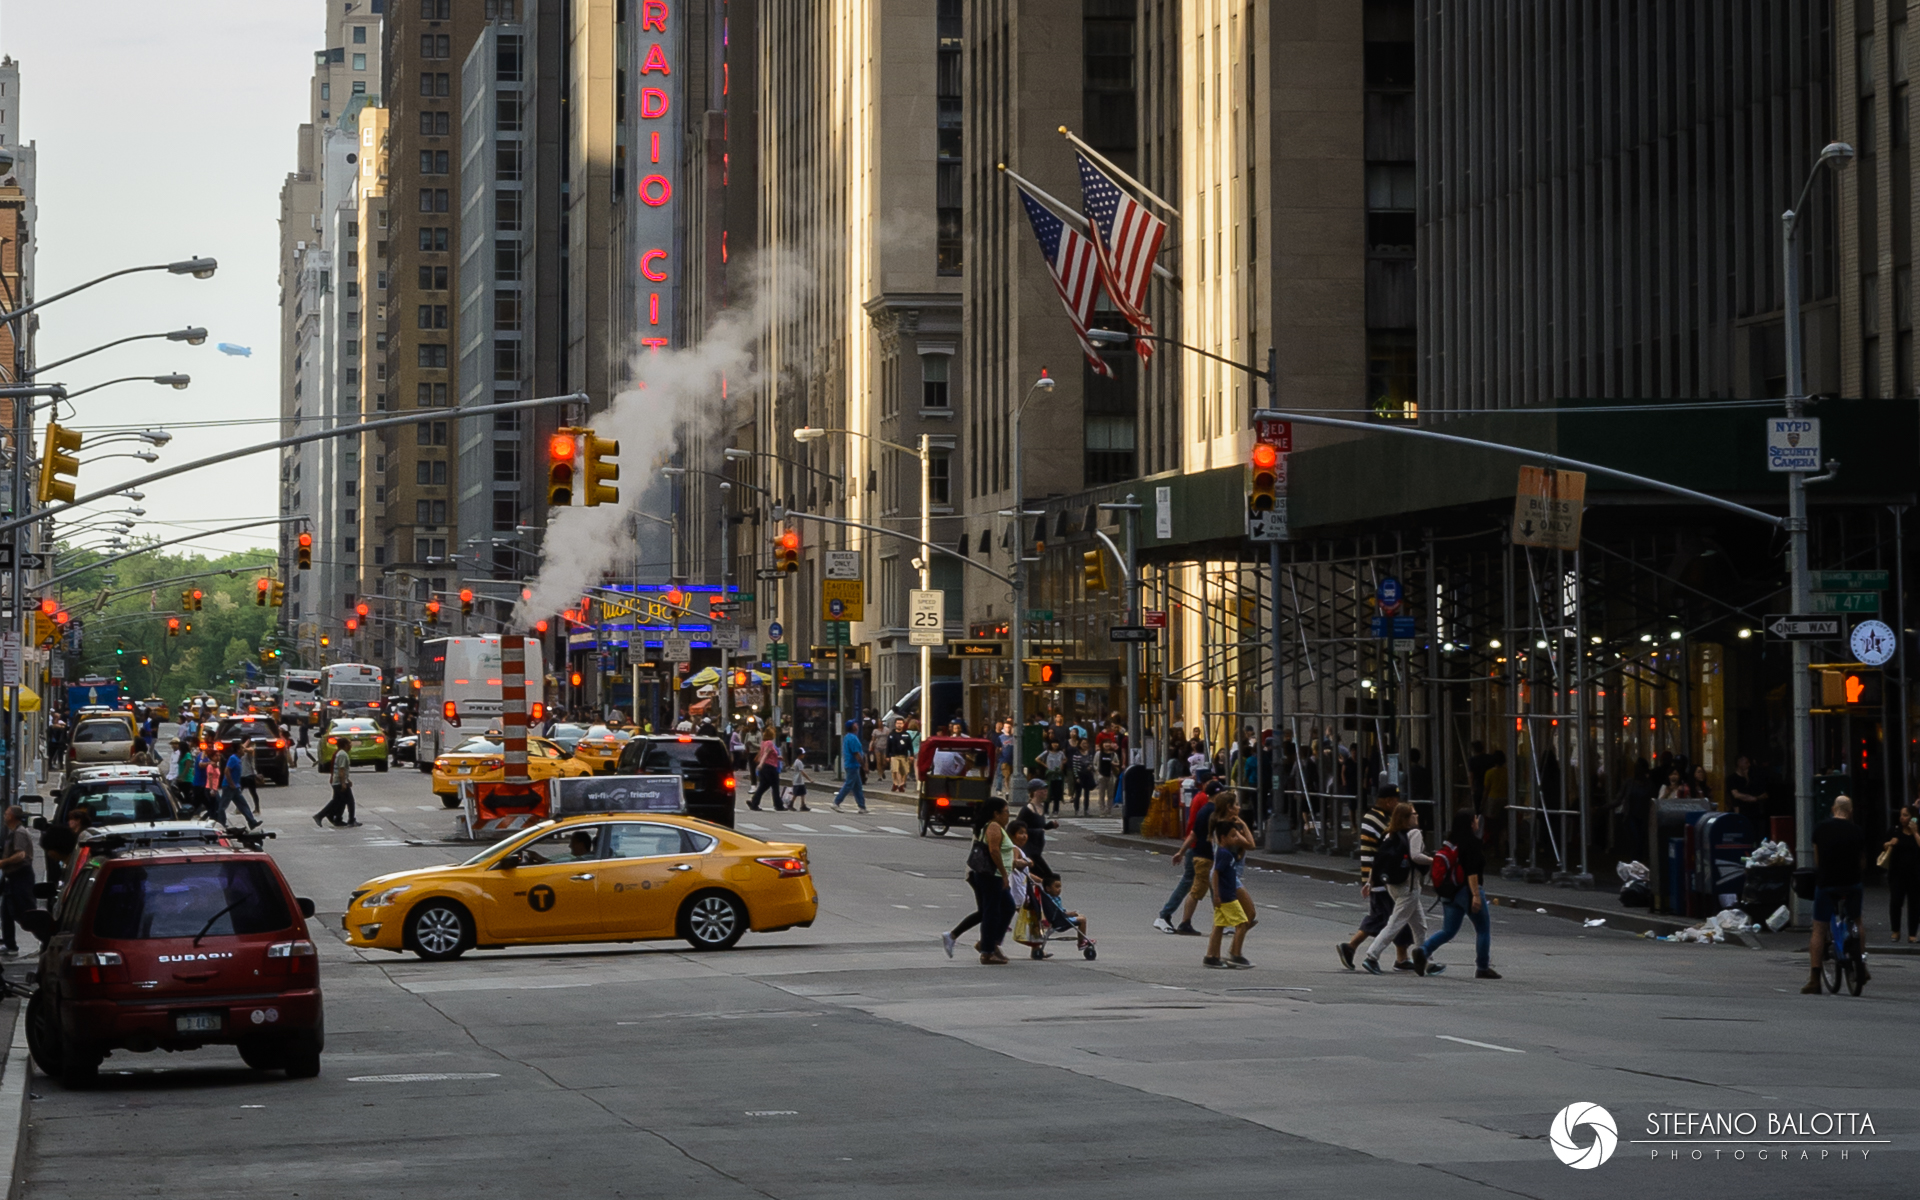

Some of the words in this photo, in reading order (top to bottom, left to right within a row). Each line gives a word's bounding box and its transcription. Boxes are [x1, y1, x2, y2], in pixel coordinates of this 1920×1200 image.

[639, 0, 671, 207] RADIO
[1775, 421, 1812, 432] NYPD
[1529, 499, 1570, 514] BUSES
[1540, 520, 1571, 532] ONLY
[1826, 596, 1837, 610] W
[1843, 595, 1861, 609] 47
[915, 612, 938, 627] 25
[1776, 622, 1799, 634] ONE
[1808, 622, 1833, 633] WAY
[965, 645, 993, 655] Subway
[630, 790, 661, 800] friendly
[533, 889, 549, 909] T
[158, 952, 234, 963] SUBARU
